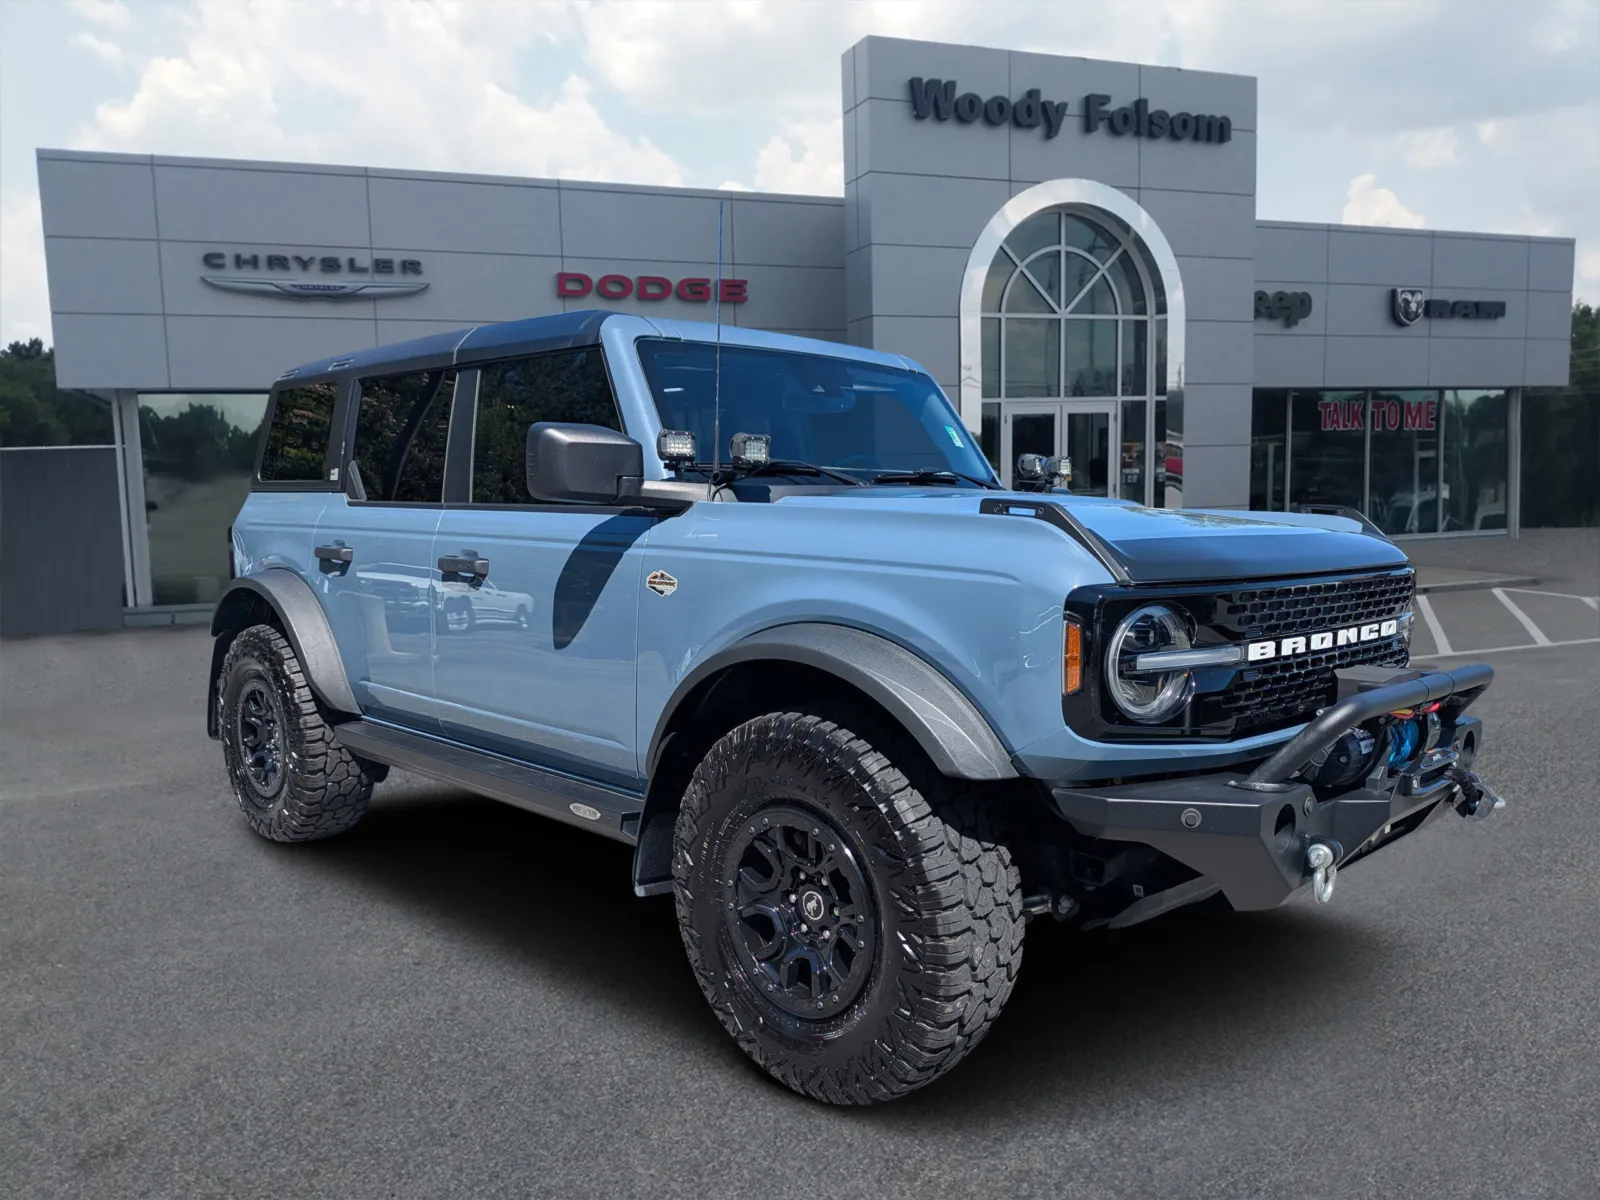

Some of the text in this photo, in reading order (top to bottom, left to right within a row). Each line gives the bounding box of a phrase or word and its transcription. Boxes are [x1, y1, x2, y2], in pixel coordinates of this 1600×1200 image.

[909, 77, 1232, 144] Woody Folsom
[203, 252, 423, 275] CHRYSLER
[556, 272, 748, 303] DODGE
[1254, 290, 1312, 328] eep
[1424, 300, 1506, 319] RAM
[1318, 400, 1437, 431] TALK TO ME
[1248, 620, 1397, 661] BRONCO
